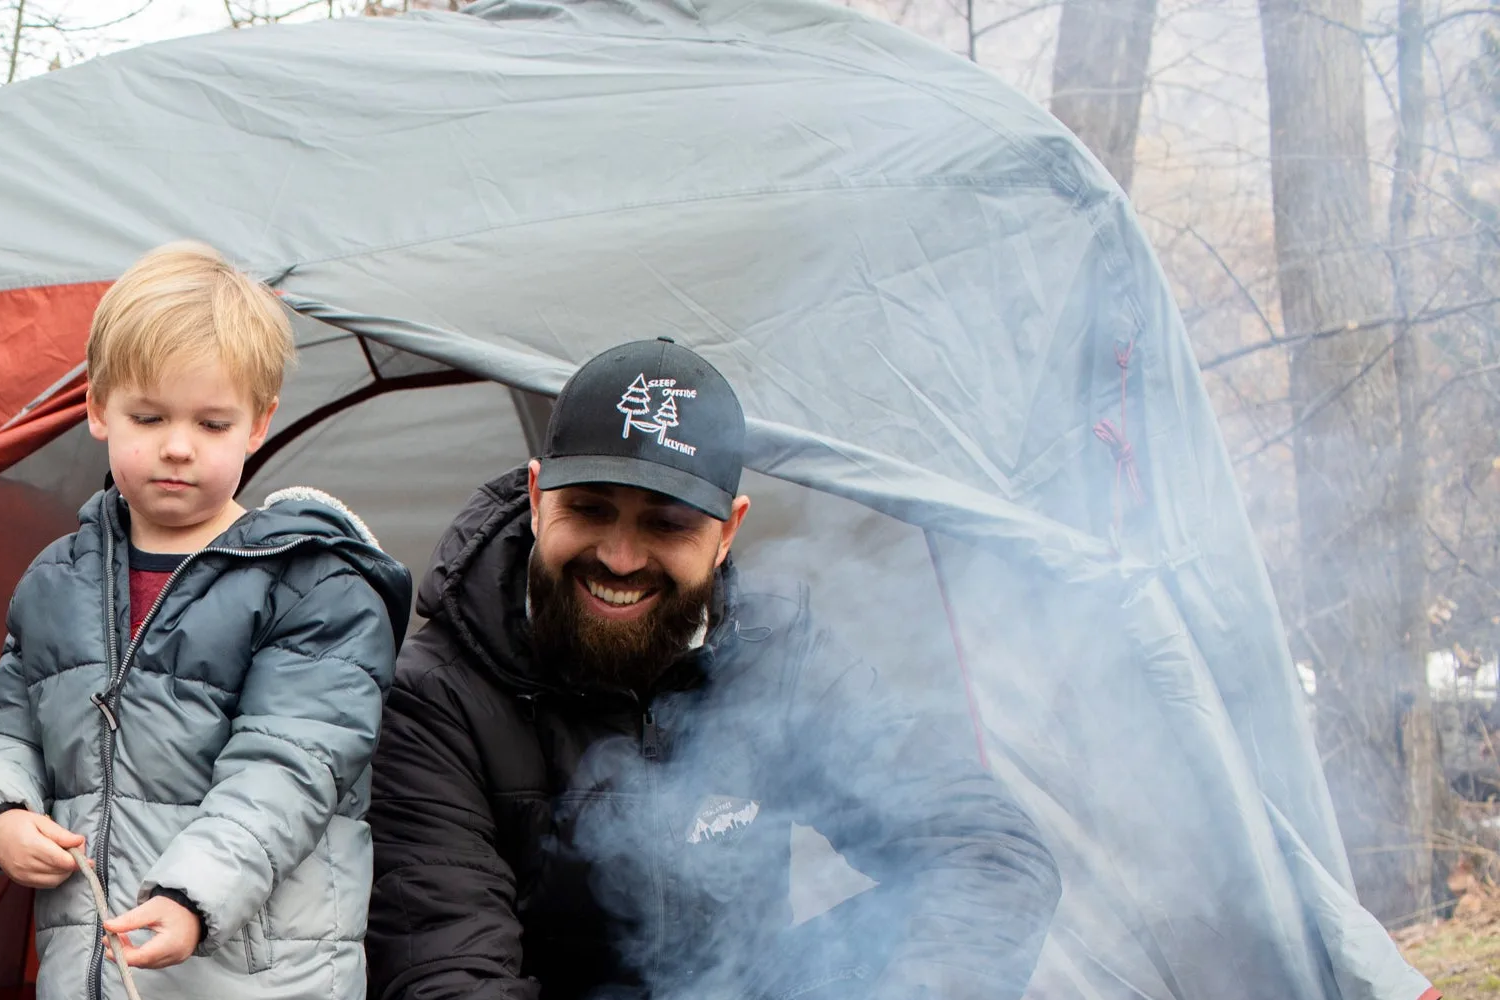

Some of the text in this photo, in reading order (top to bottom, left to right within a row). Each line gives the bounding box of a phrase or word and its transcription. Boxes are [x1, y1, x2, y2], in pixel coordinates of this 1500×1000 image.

[647, 379, 676, 388] SLEEP
[662, 388, 697, 398] OUTSIDE
[663, 438, 697, 456] KLYMIT
